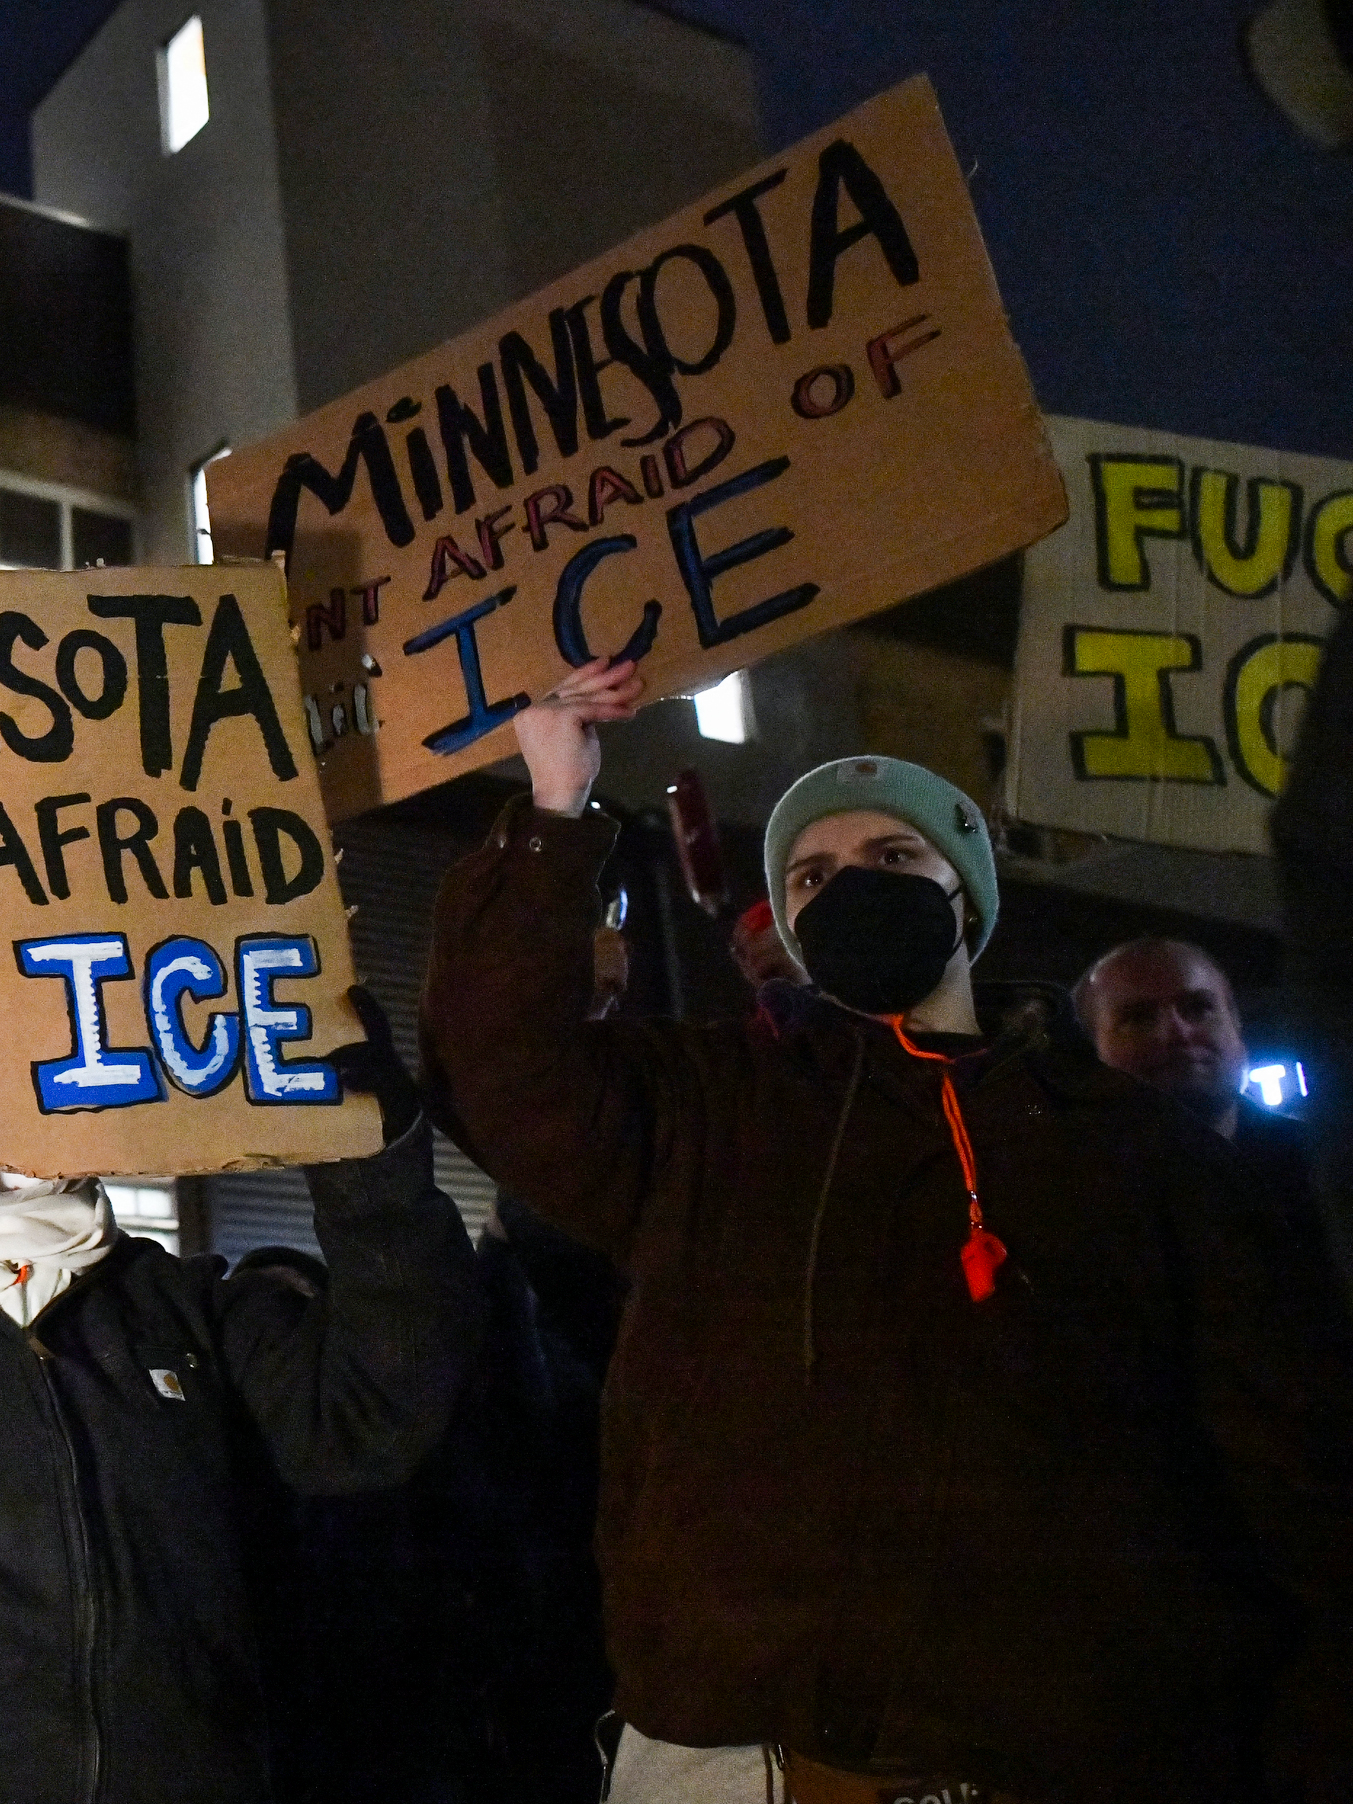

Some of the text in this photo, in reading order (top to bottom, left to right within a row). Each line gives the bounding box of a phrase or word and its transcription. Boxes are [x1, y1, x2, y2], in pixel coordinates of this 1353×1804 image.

[423, 415, 736, 602] AFRAID
[790, 313, 943, 420] OF
[402, 455, 822, 757] ICE
[13, 932, 343, 1115] ICE
